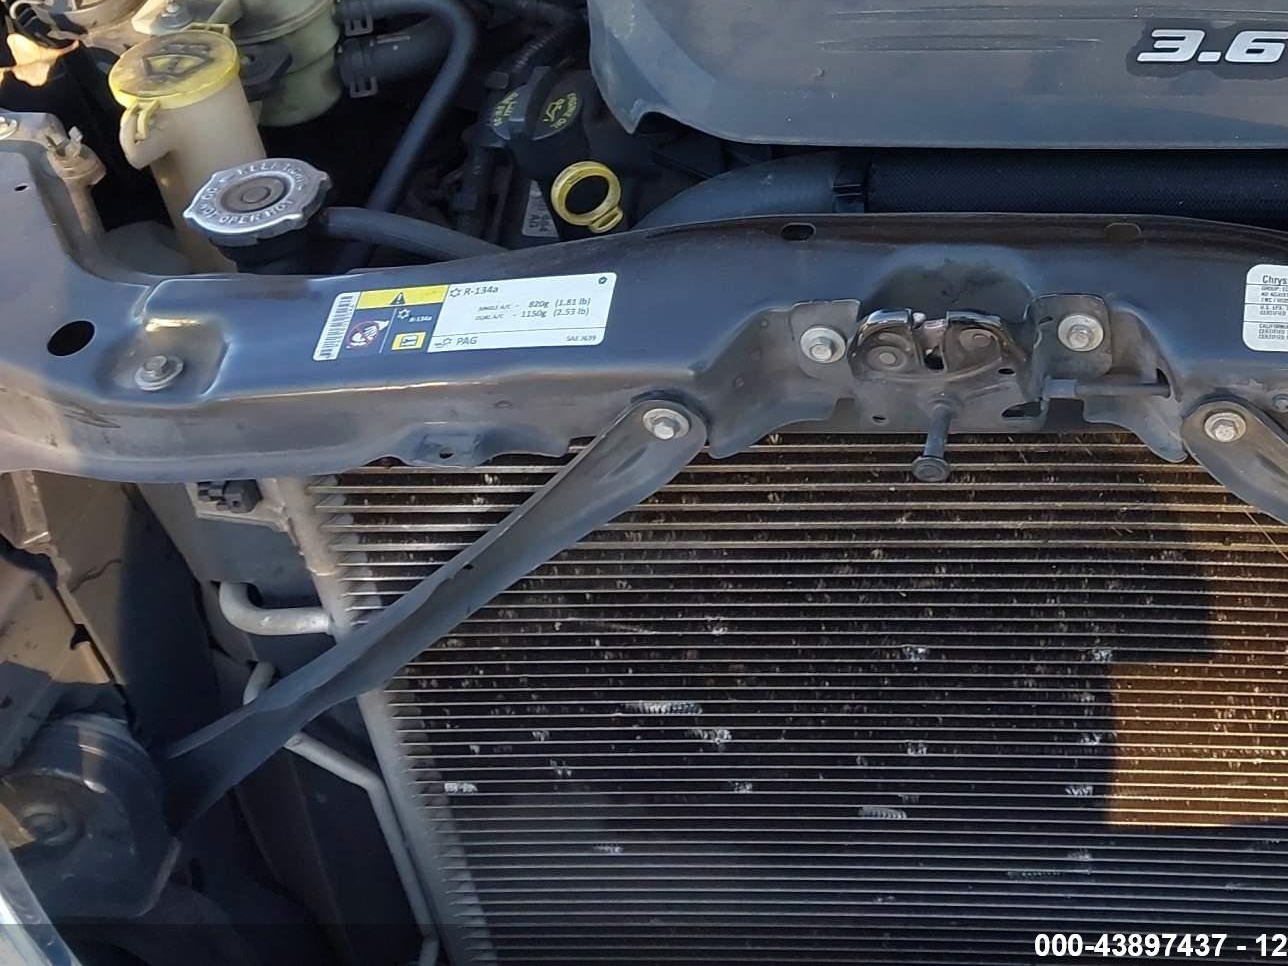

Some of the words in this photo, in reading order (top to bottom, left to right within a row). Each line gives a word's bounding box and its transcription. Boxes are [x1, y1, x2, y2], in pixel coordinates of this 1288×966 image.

[463, 286, 499, 296] R-134a
[528, 300, 549, 308] 820g
[555, 299, 577, 308] (1.81
[579, 297, 591, 307] lb)
[520, 310, 547, 318] 1150g
[553, 308, 576, 317] (2.53
[577, 307, 589, 316] lb)
[456, 336, 478, 346] PAG
